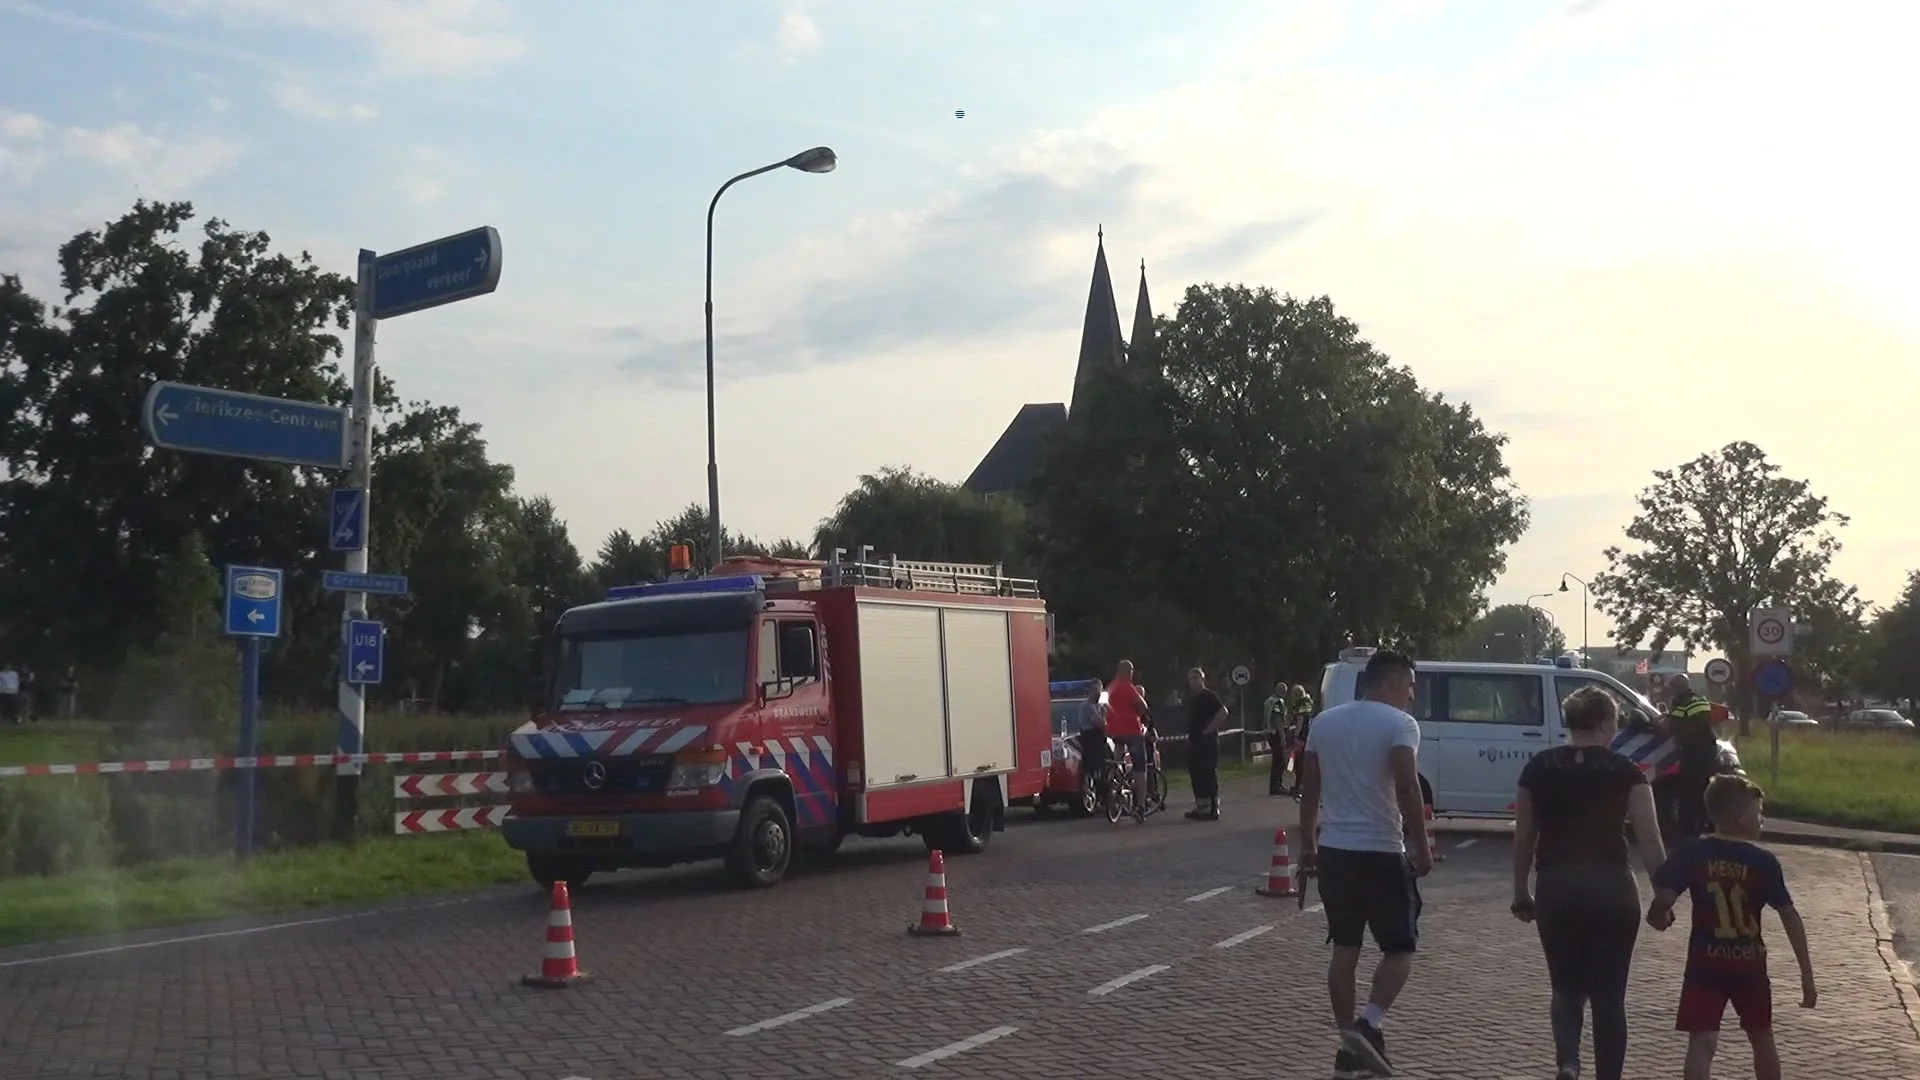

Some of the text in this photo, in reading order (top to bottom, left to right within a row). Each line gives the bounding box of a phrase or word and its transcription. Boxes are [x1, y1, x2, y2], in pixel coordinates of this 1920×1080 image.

[1762, 626, 1780, 637] 30
[355, 635, 376, 647] U18
[1707, 860, 1748, 880] MESSI
[1706, 880, 1760, 939] 10
